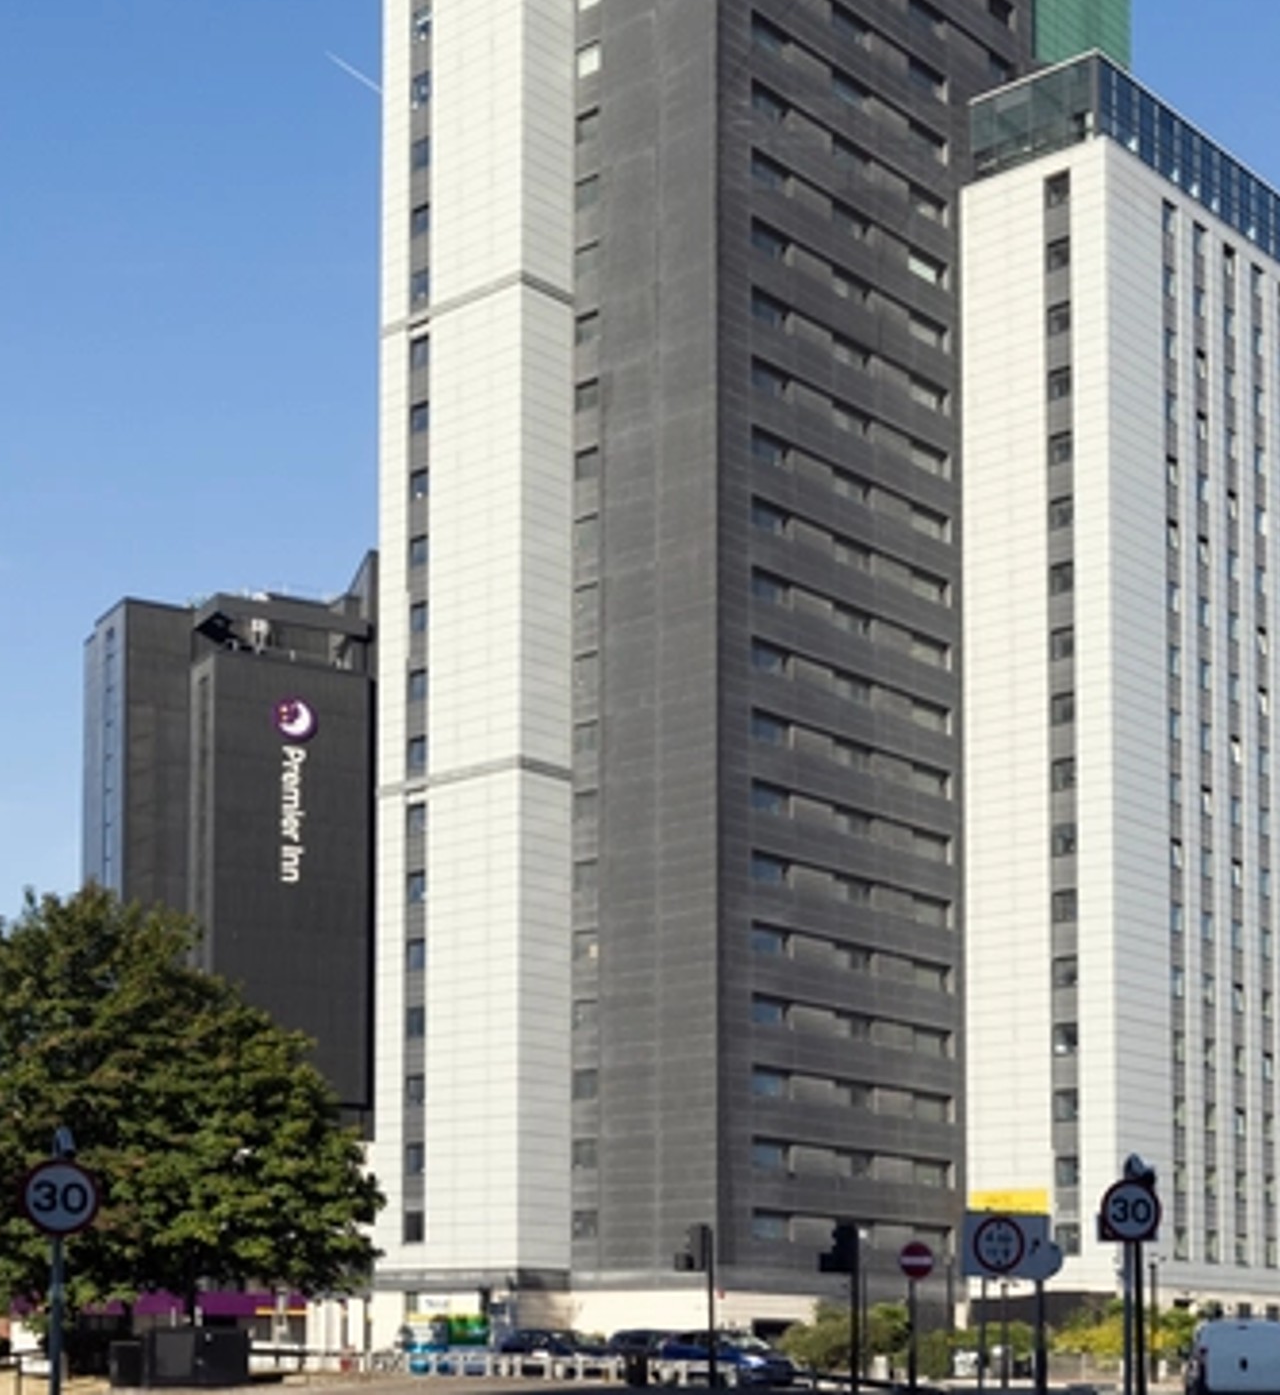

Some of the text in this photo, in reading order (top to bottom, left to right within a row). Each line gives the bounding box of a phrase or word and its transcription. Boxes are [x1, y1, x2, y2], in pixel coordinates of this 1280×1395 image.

[280, 745, 306, 883] Premier Inn
[33, 1180, 88, 1215] 30
[1112, 1196, 1151, 1224] 30
